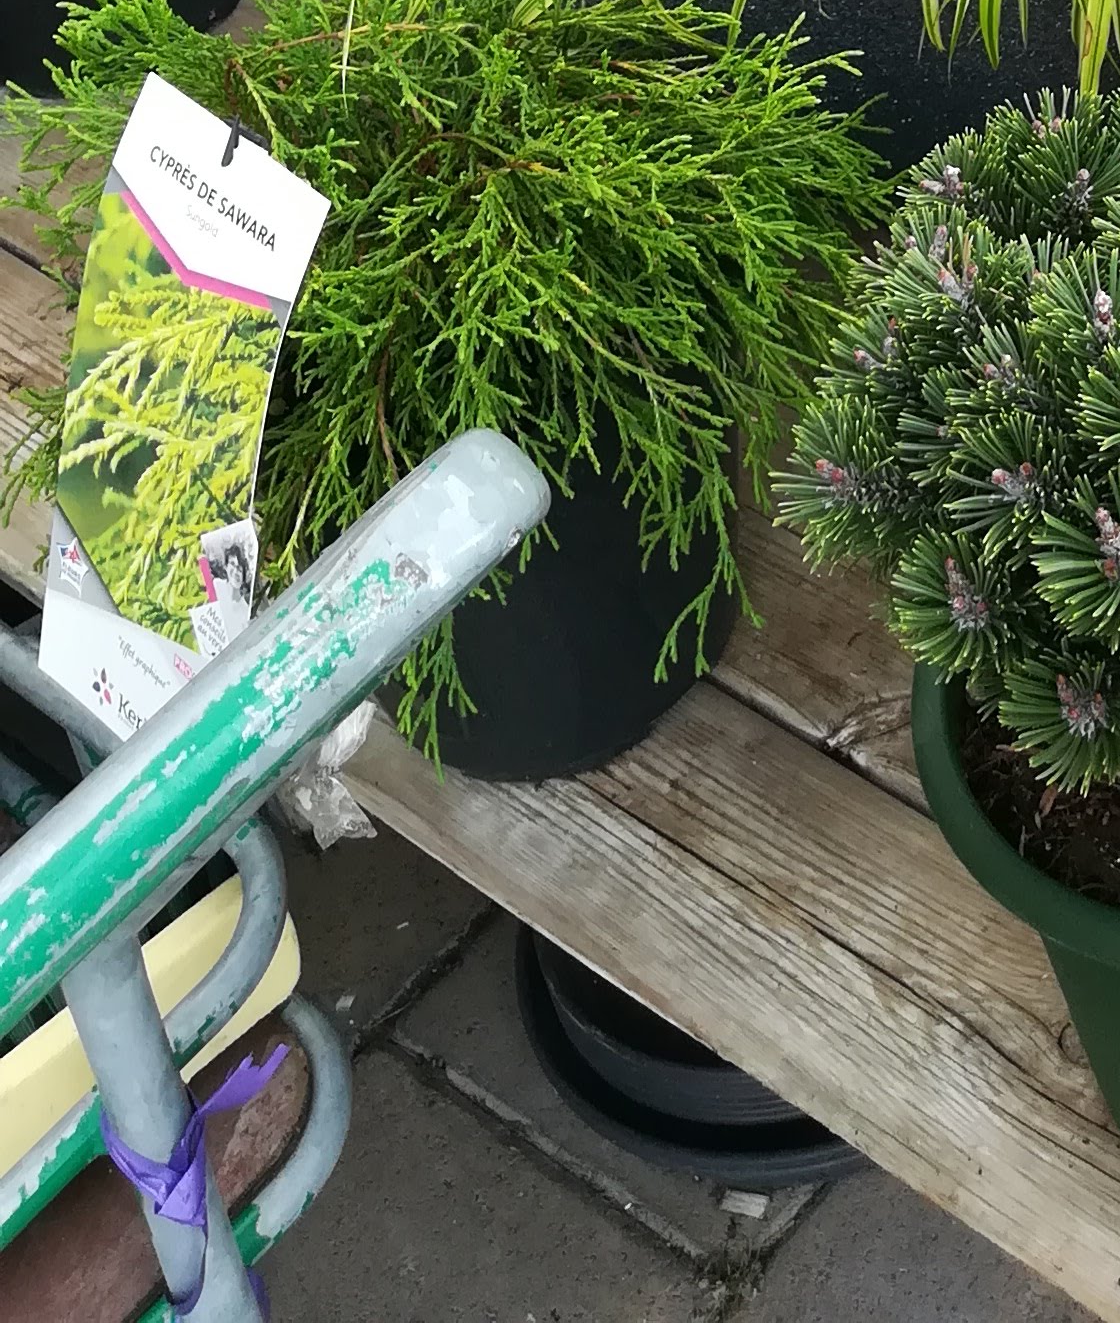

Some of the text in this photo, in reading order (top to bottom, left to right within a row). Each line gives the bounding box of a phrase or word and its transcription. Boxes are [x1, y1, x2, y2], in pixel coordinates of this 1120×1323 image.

[197, 182, 217, 206] DE
[218, 197, 276, 251] SAWARA
[118, 692, 145, 729] Ker
